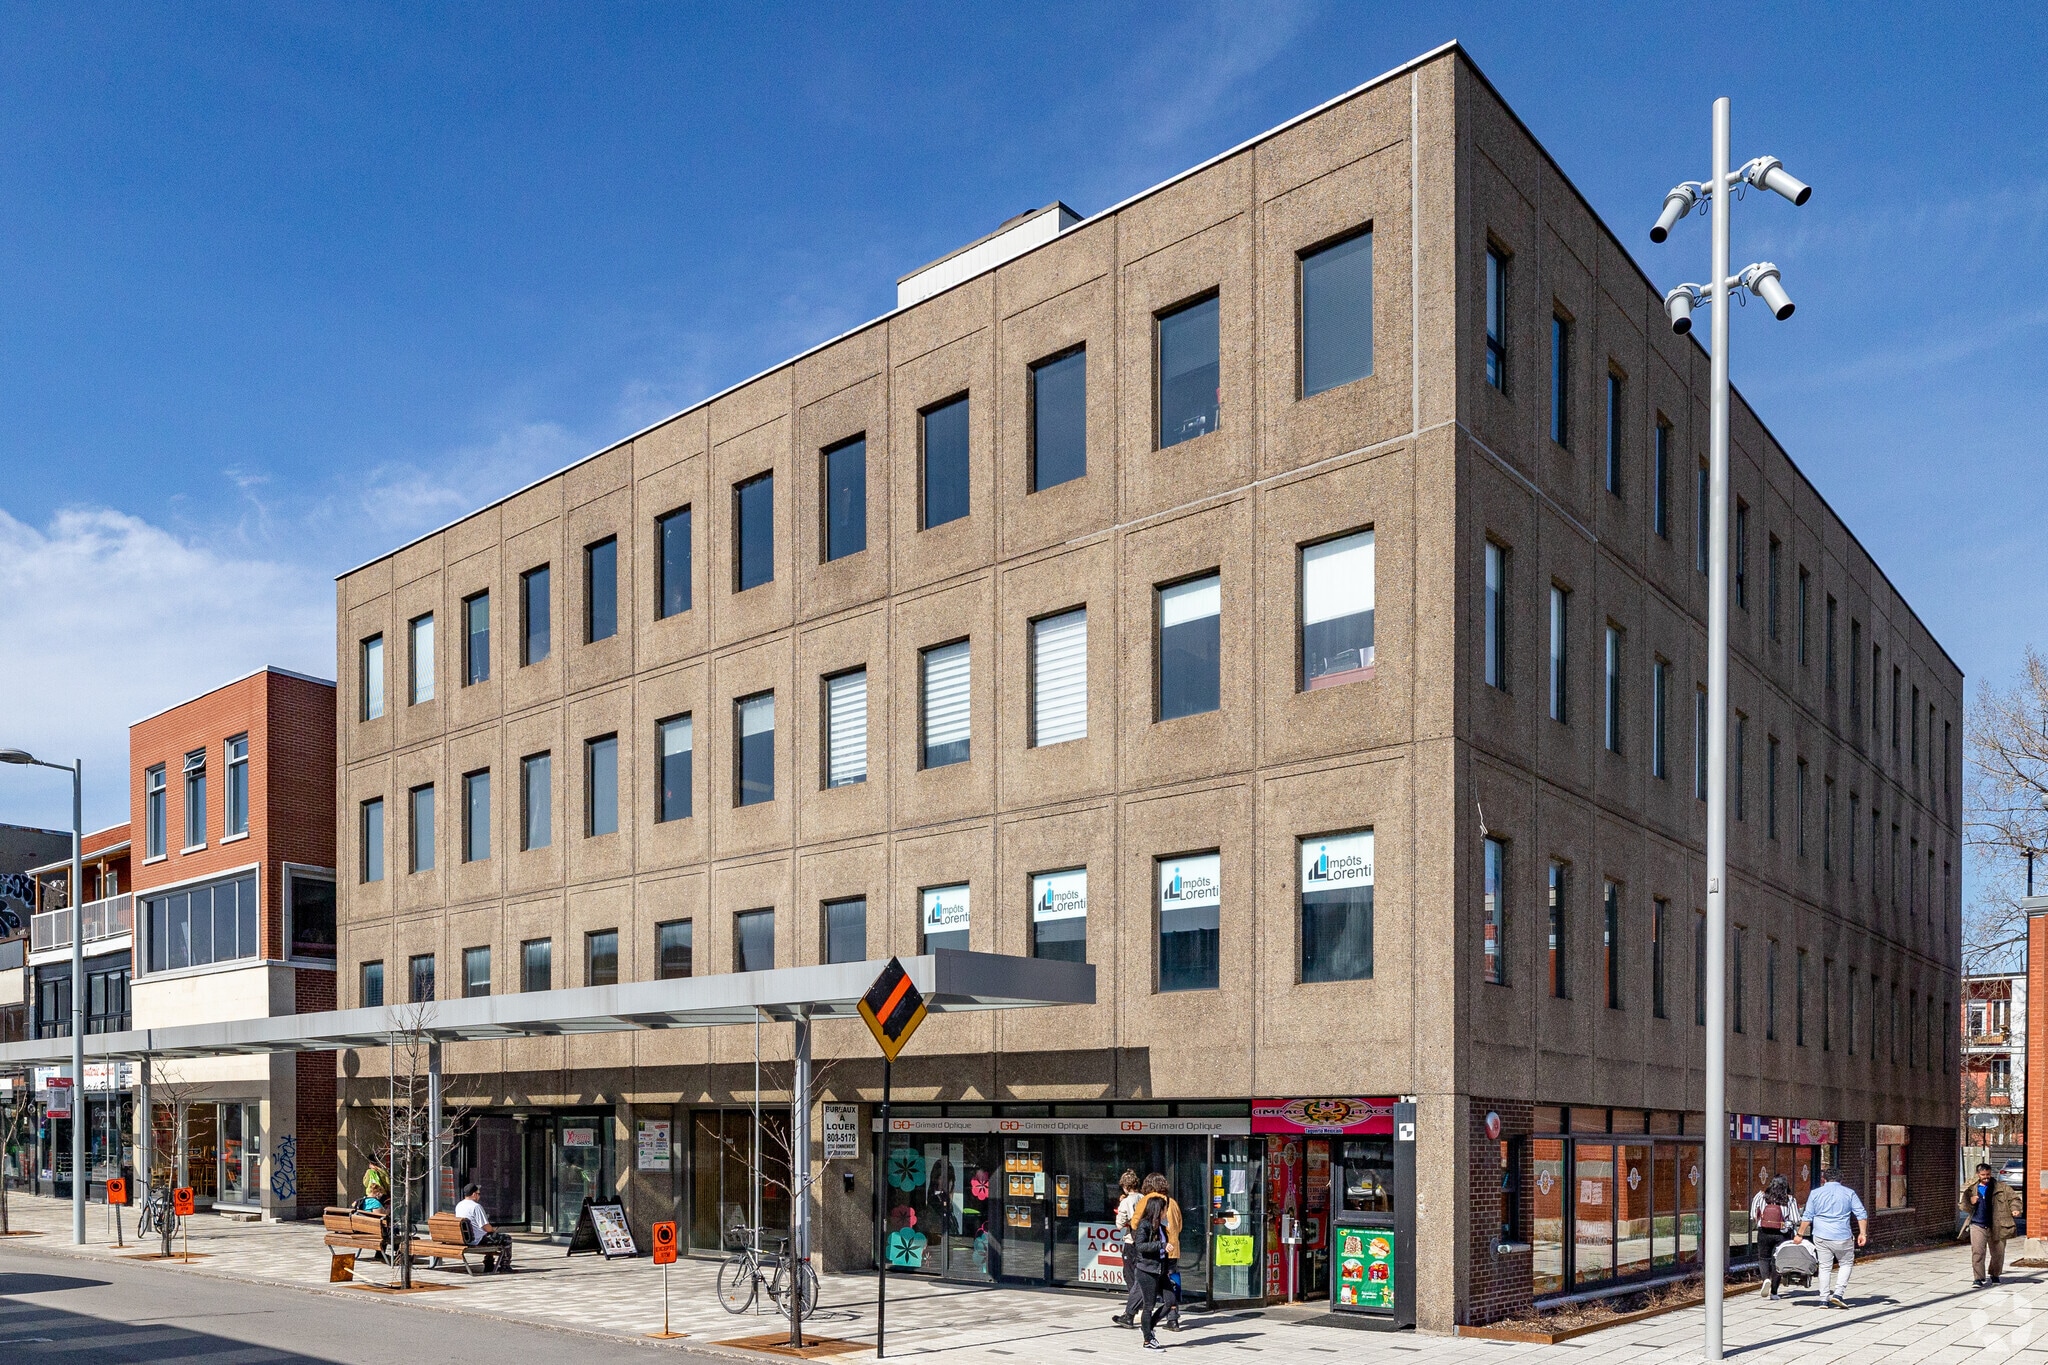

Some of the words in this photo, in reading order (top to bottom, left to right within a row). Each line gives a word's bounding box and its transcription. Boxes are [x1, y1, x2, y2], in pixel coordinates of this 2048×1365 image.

[1326, 855, 1362, 870] Impôts
[1326, 865, 1372, 882] Lorenti
[1179, 876, 1211, 890] Impôts
[1052, 889, 1079, 904] Impôts
[1179, 886, 1219, 901] Lorenti
[940, 903, 964, 916] Impôts
[1052, 898, 1087, 913] Lorenti
[826, 1123, 856, 1131] LOUER
[915, 1121, 943, 1129] Grimard
[943, 1121, 972, 1130] Optique
[1025, 1122, 1056, 1130] Grimard
[1057, 1122, 1089, 1130] Optique
[1149, 1122, 1185, 1130] Grimard
[1186, 1122, 1222, 1131] Optique
[1087, 1227, 1124, 1242] LOC
